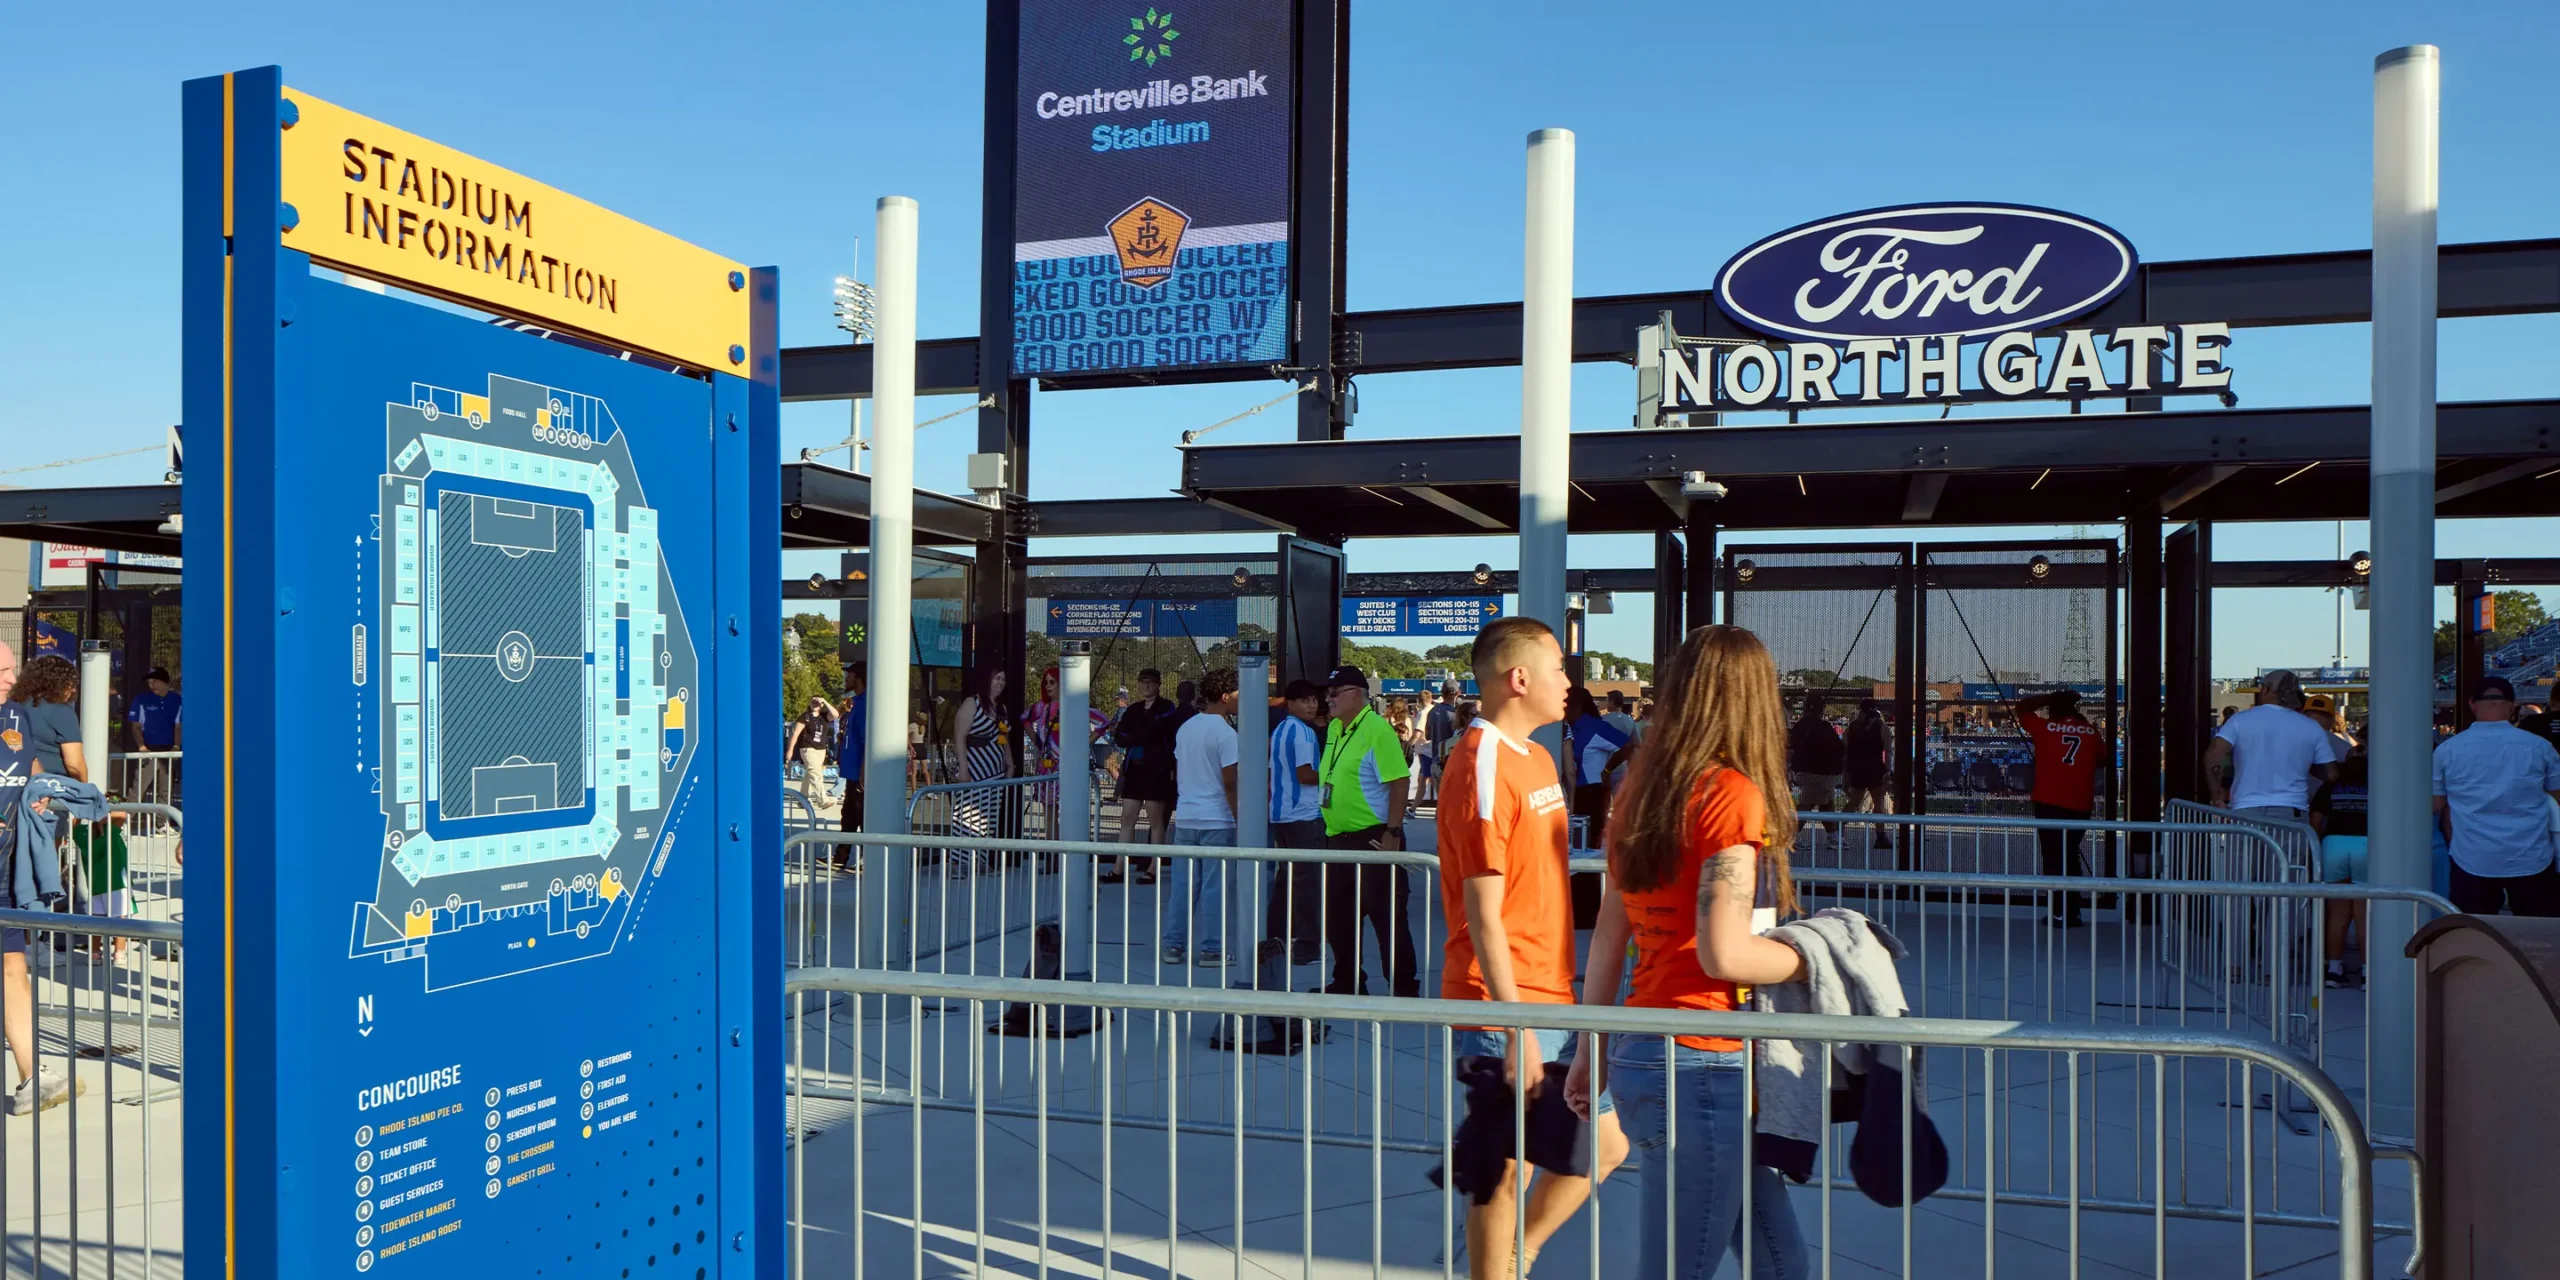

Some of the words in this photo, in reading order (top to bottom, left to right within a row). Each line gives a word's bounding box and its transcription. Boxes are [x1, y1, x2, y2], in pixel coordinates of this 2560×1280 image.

[1037, 80, 1188, 119] Centreville
[1191, 69, 1268, 103] Bank
[1090, 118, 1210, 151] Stadium
[343, 138, 533, 238] STADIUM
[345, 192, 618, 313] INFORMATION
[1124, 268, 1145, 276] RHODE
[1148, 267, 1170, 275] ISLAND
[1795, 225, 2050, 323] Ford
[1097, 304, 1210, 338] SOCCER
[1068, 340, 1145, 370] GOOD
[1155, 332, 1260, 366] SOCCE
[1661, 335, 1966, 408] NORTH
[1979, 322, 2232, 397] GATE
[2047, 722, 2096, 735] CHOCO
[2061, 735, 2081, 765] 7
[0, 775, 28, 787] eze
[501, 883, 516, 891] NORTH
[517, 881, 528, 889] GATE
[508, 942, 522, 950] PLAZA
[358, 994, 373, 1024] N
[598, 1051, 632, 1068] RESTROOMS
[358, 1064, 462, 1112] CONCOURSE
[506, 1083, 527, 1097] PRESS
[529, 1079, 542, 1090] BOX
[598, 1078, 614, 1091] FIRST
[616, 1074, 626, 1084] AID
[506, 1103, 536, 1119] NURSING
[538, 1097, 556, 1109] ROOM
[598, 1094, 629, 1111] ELEVATORS
[379, 1120, 405, 1136] RHODE
[407, 1112, 435, 1128] ISLAND
[438, 1107, 450, 1119] PIE
[452, 1103, 464, 1114] CO.
[506, 1125, 536, 1142] SENSORY
[538, 1118, 556, 1131] ROOM
[598, 1120, 610, 1131] YOU
[611, 1115, 622, 1126] ARE
[623, 1110, 637, 1122] HERE
[380, 1144, 401, 1161] TEAM
[403, 1137, 428, 1153] STORE
[488, 1161, 498, 1171] 10
[507, 1153, 519, 1164] THE
[521, 1140, 555, 1160] CROSSBAR
[380, 1167, 407, 1185] TICKET
[410, 1158, 436, 1175] OFFICE
[488, 1183, 498, 1193] 11
[507, 1170, 535, 1187] GANSETT
[537, 1162, 556, 1176] GRILL
[380, 1193, 404, 1210] GUEST
[407, 1180, 443, 1200] SERVICES
[380, 1210, 424, 1234] TIDEWATER
[426, 1198, 456, 1218] MARKET
[380, 1241, 406, 1259] RHODE
[408, 1231, 436, 1249] ISLAND
[438, 1220, 462, 1236] ROOST
